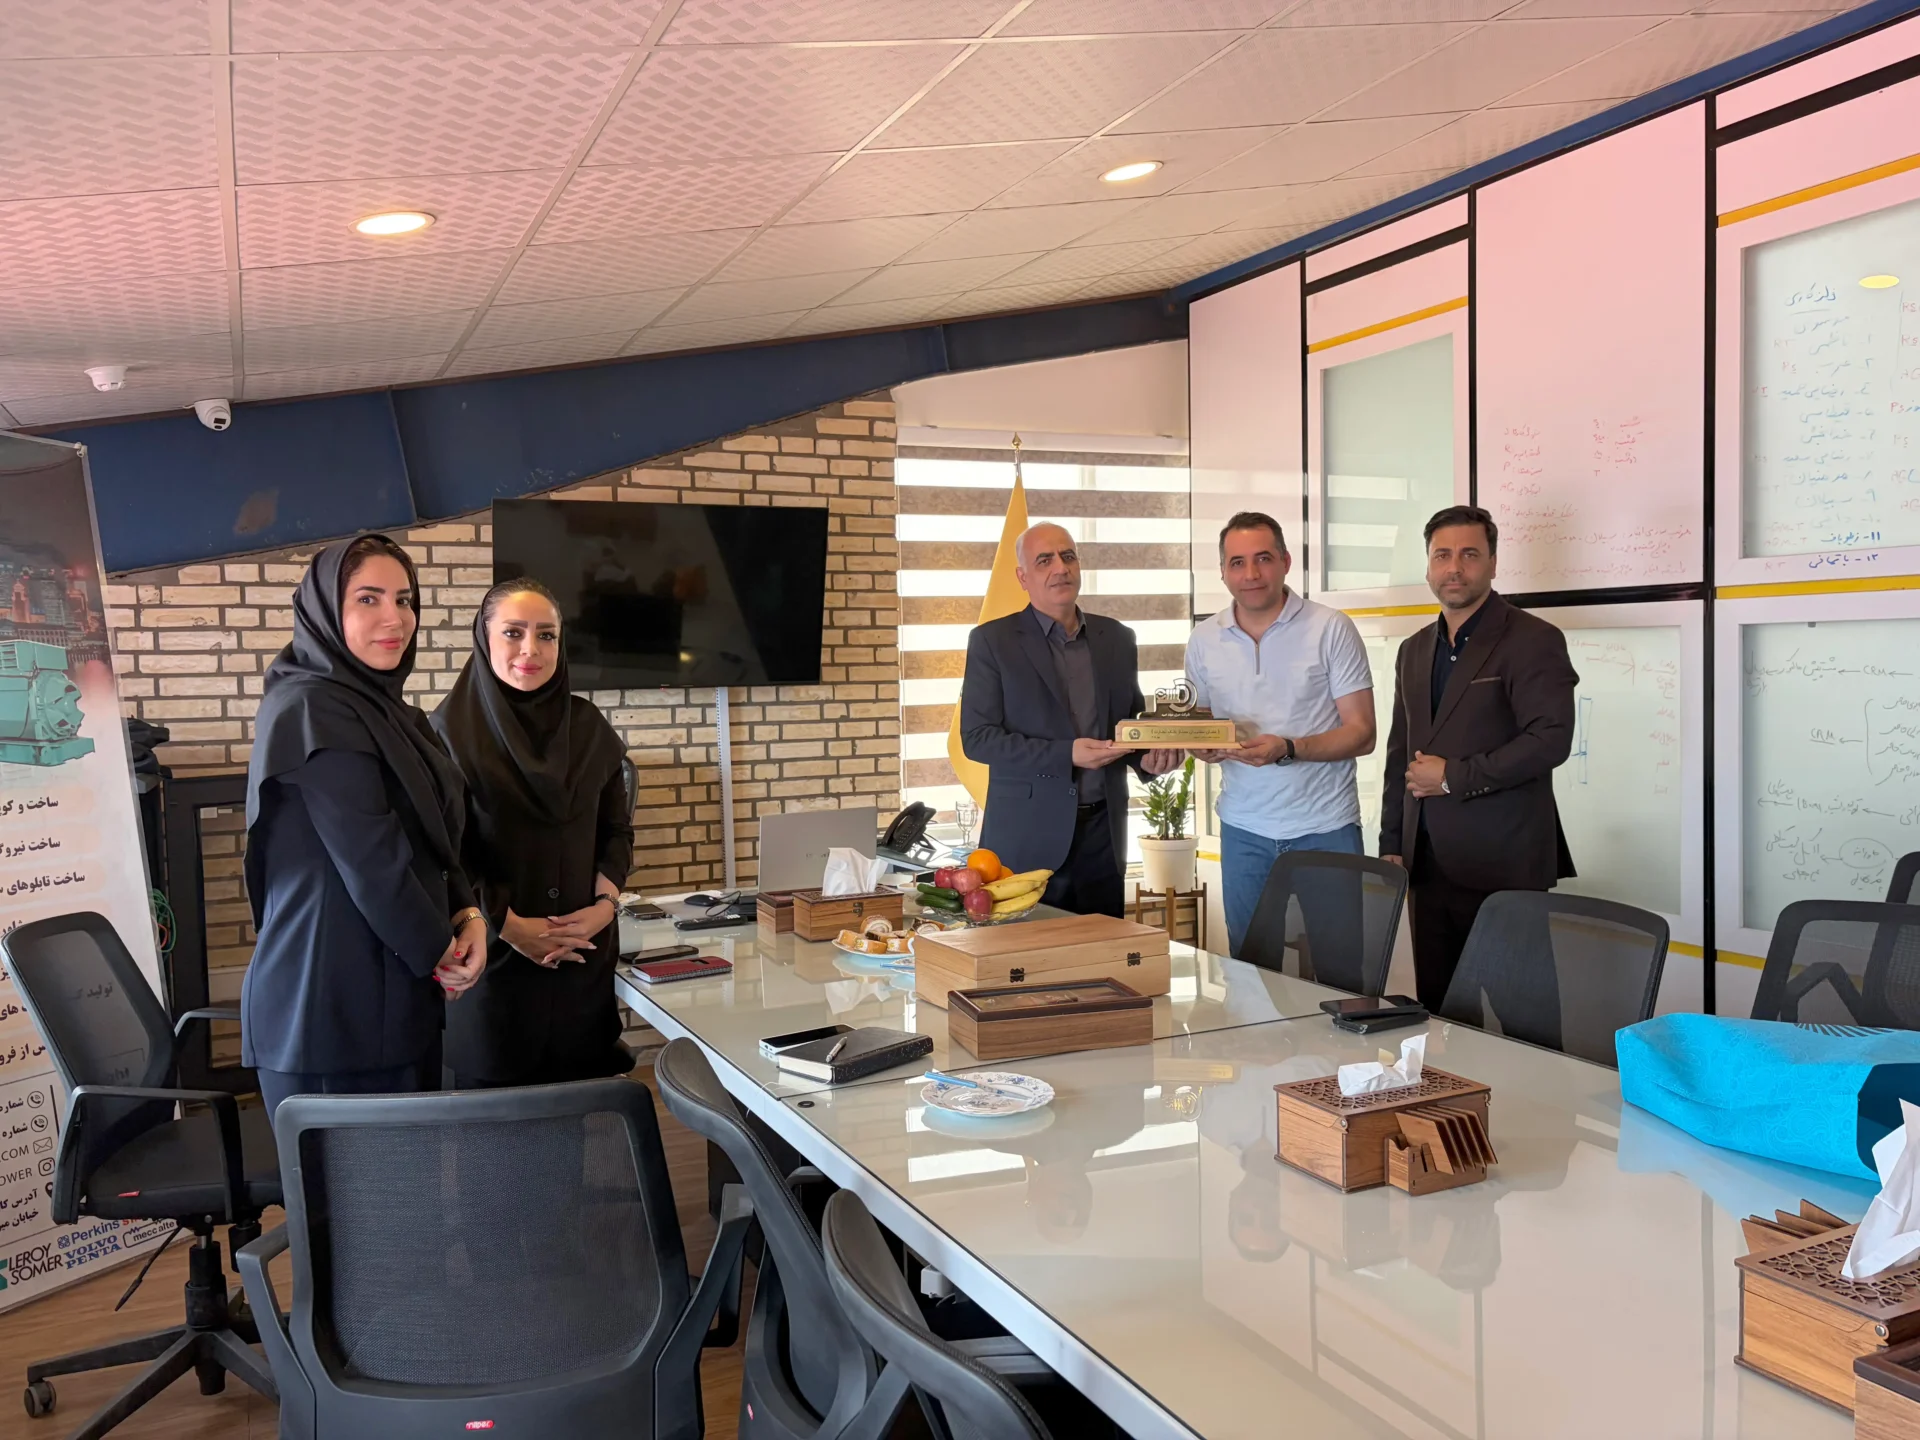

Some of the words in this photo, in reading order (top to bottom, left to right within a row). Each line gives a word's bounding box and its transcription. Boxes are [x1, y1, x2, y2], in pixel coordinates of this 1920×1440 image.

[17, 802, 24, 815] و
[26, 795, 59, 810] ساخت
[28, 836, 61, 851] ساخت
[6, 874, 51, 896] تابلوهای
[53, 871, 86, 886] ساخت
[0, 1045, 17, 1066] فرو
[20, 1042, 30, 1061] از
[2, 1122, 29, 1140] شماره
[0, 1144, 30, 1163] .COM
[0, 1167, 33, 1187] OWER
[11, 1187, 38, 1208] آدرس
[12, 1208, 39, 1227] خیابان
[71, 1221, 120, 1245] Perkins
[133, 1228, 158, 1242] mecc
[158, 1220, 175, 1233] alte
[8, 1242, 52, 1271] LEROY
[64, 1235, 118, 1260] VOLVO
[65, 1243, 122, 1271] PENTA
[10, 1254, 64, 1285] SOMER
